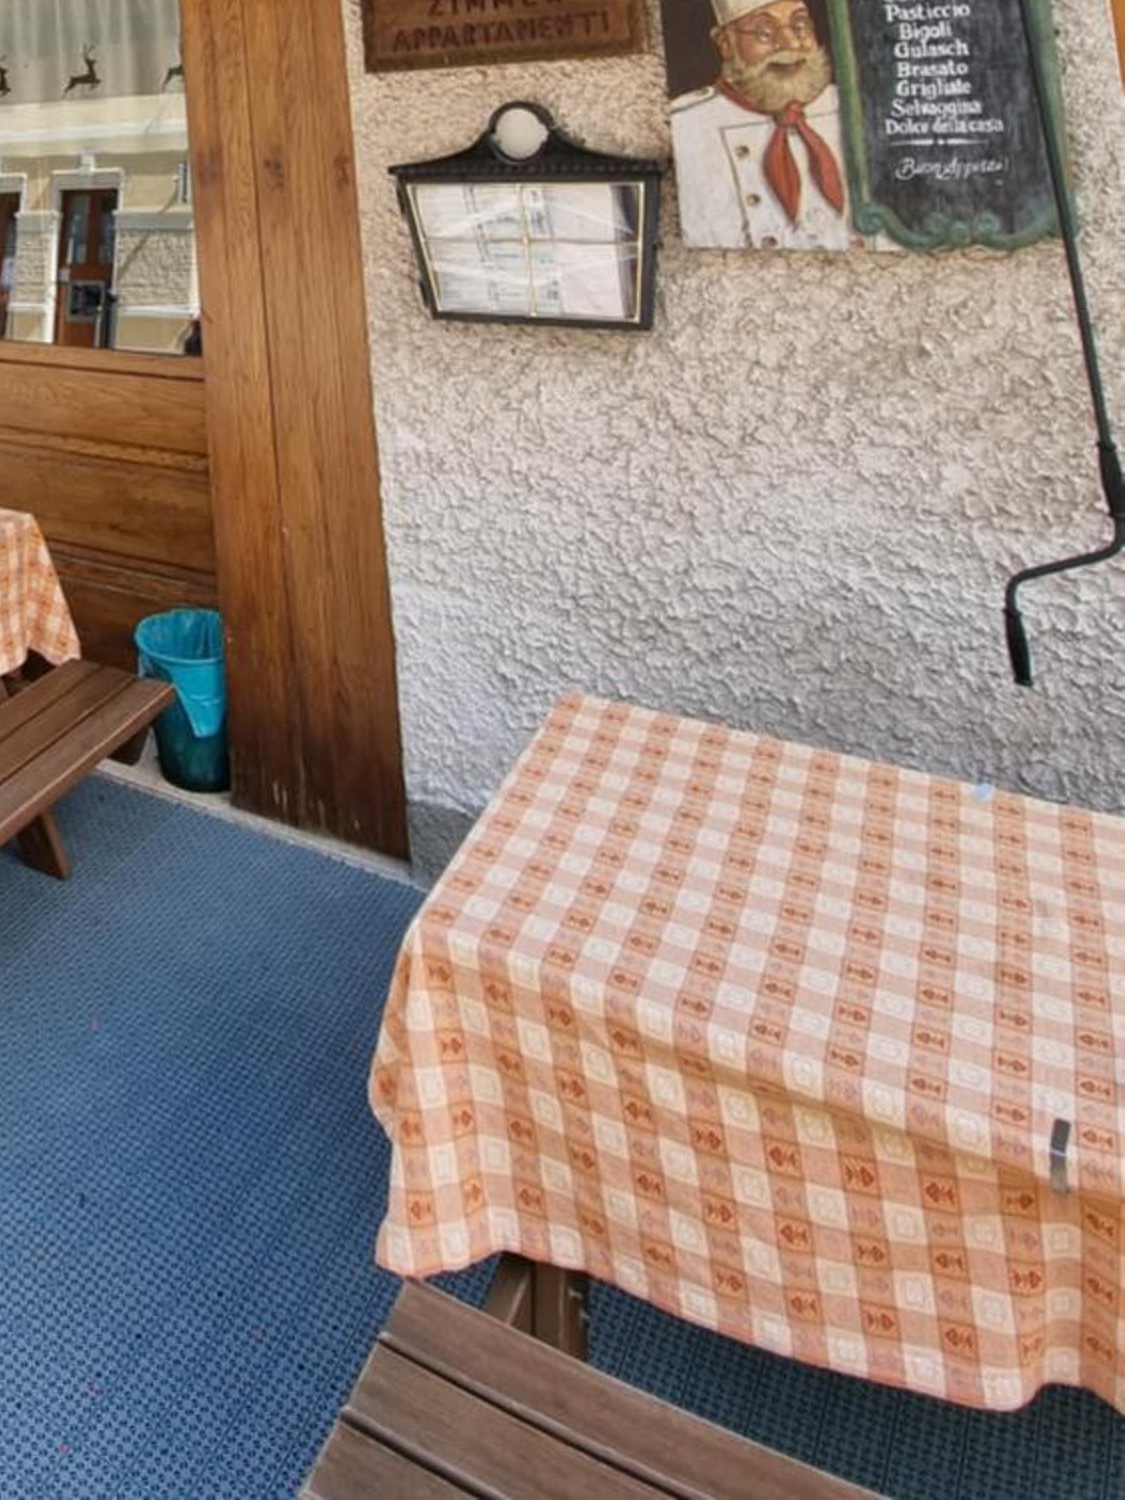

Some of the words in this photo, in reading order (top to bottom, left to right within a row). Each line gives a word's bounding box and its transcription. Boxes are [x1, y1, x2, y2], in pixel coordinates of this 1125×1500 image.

[885, 3, 971, 22] Pasticcio
[393, 11, 610, 52] APPARTAMENTI
[899, 21, 952, 43] Bigoli
[894, 39, 970, 58] Gulasch
[896, 60, 969, 78] Brasato
[896, 78, 972, 100] Grigliate
[891, 99, 982, 119] Selvaggina
[885, 118, 929, 134] Dolce
